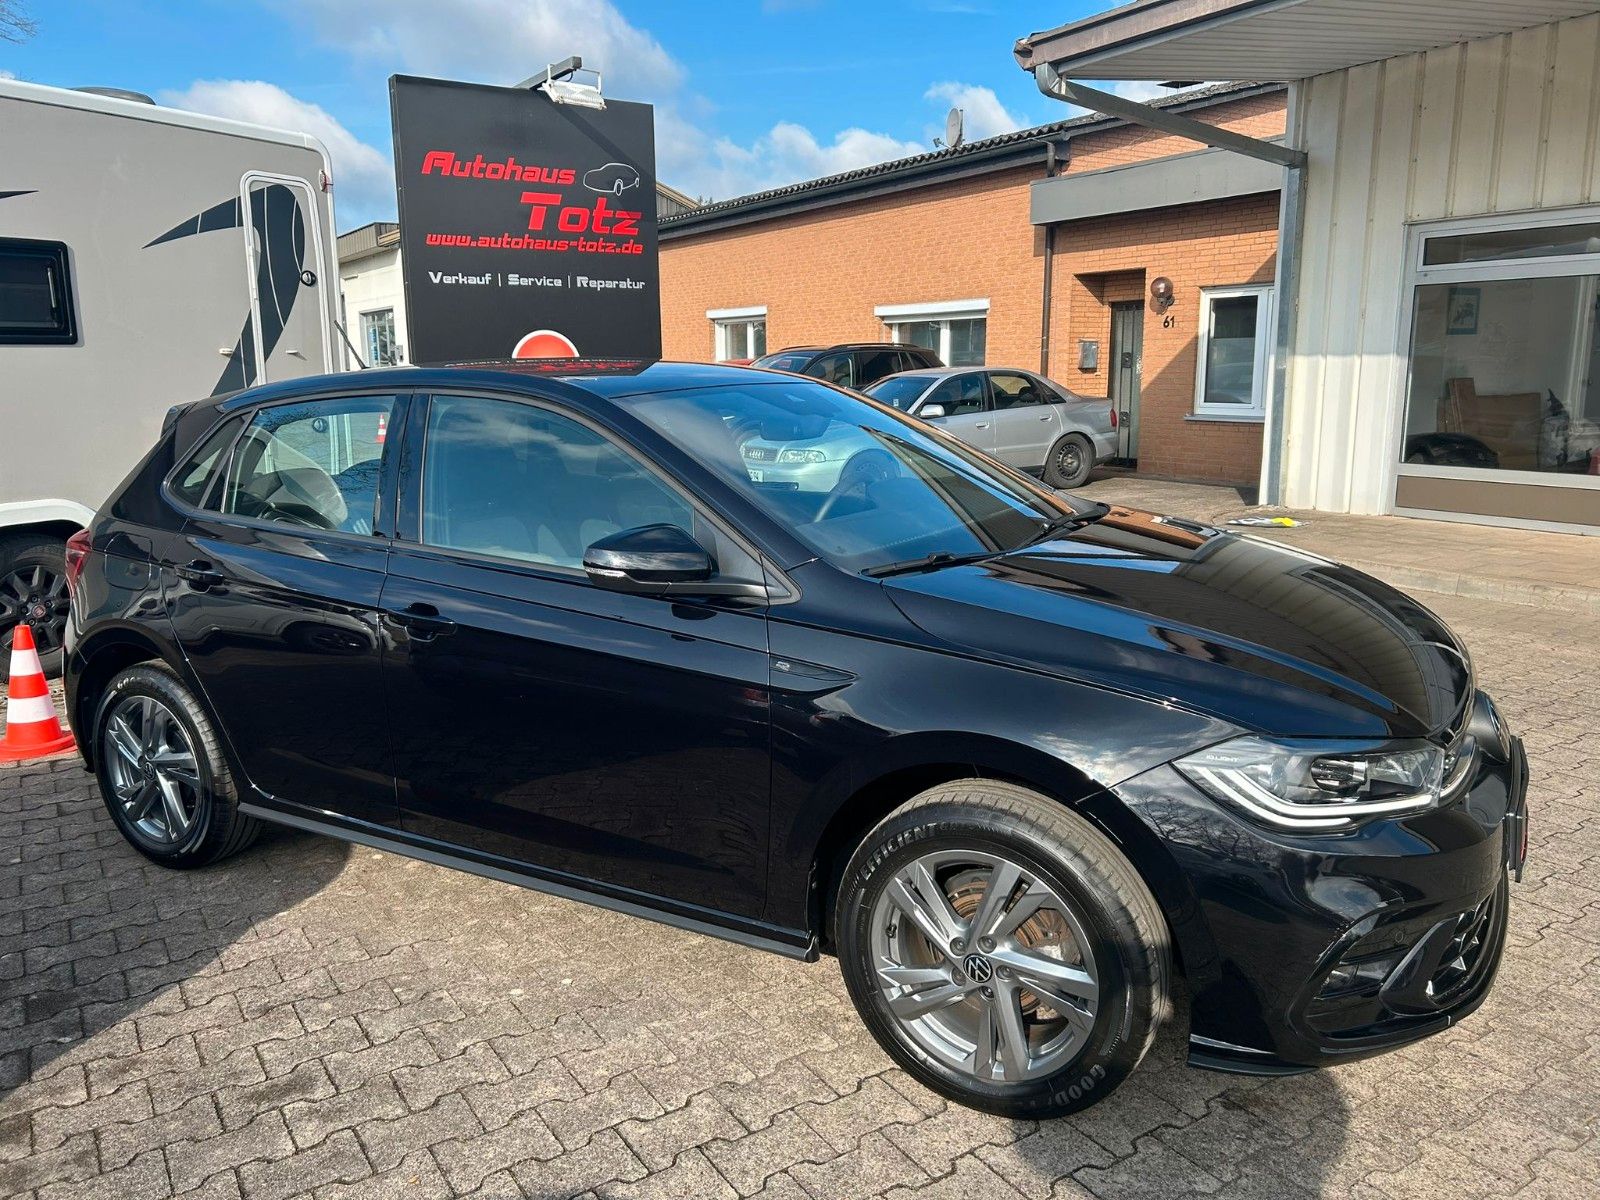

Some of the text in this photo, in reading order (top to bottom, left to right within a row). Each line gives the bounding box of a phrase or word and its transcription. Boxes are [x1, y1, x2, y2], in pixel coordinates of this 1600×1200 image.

[421, 150, 576, 186] Autohaus
[520, 191, 642, 236] Totz
[425, 232, 644, 255] www.autohaus-totz.de
[428, 271, 646, 291] Verkauf Service Reparatur
[1163, 315, 1175, 328] 61
[859, 821, 938, 881] EFFICIENT
